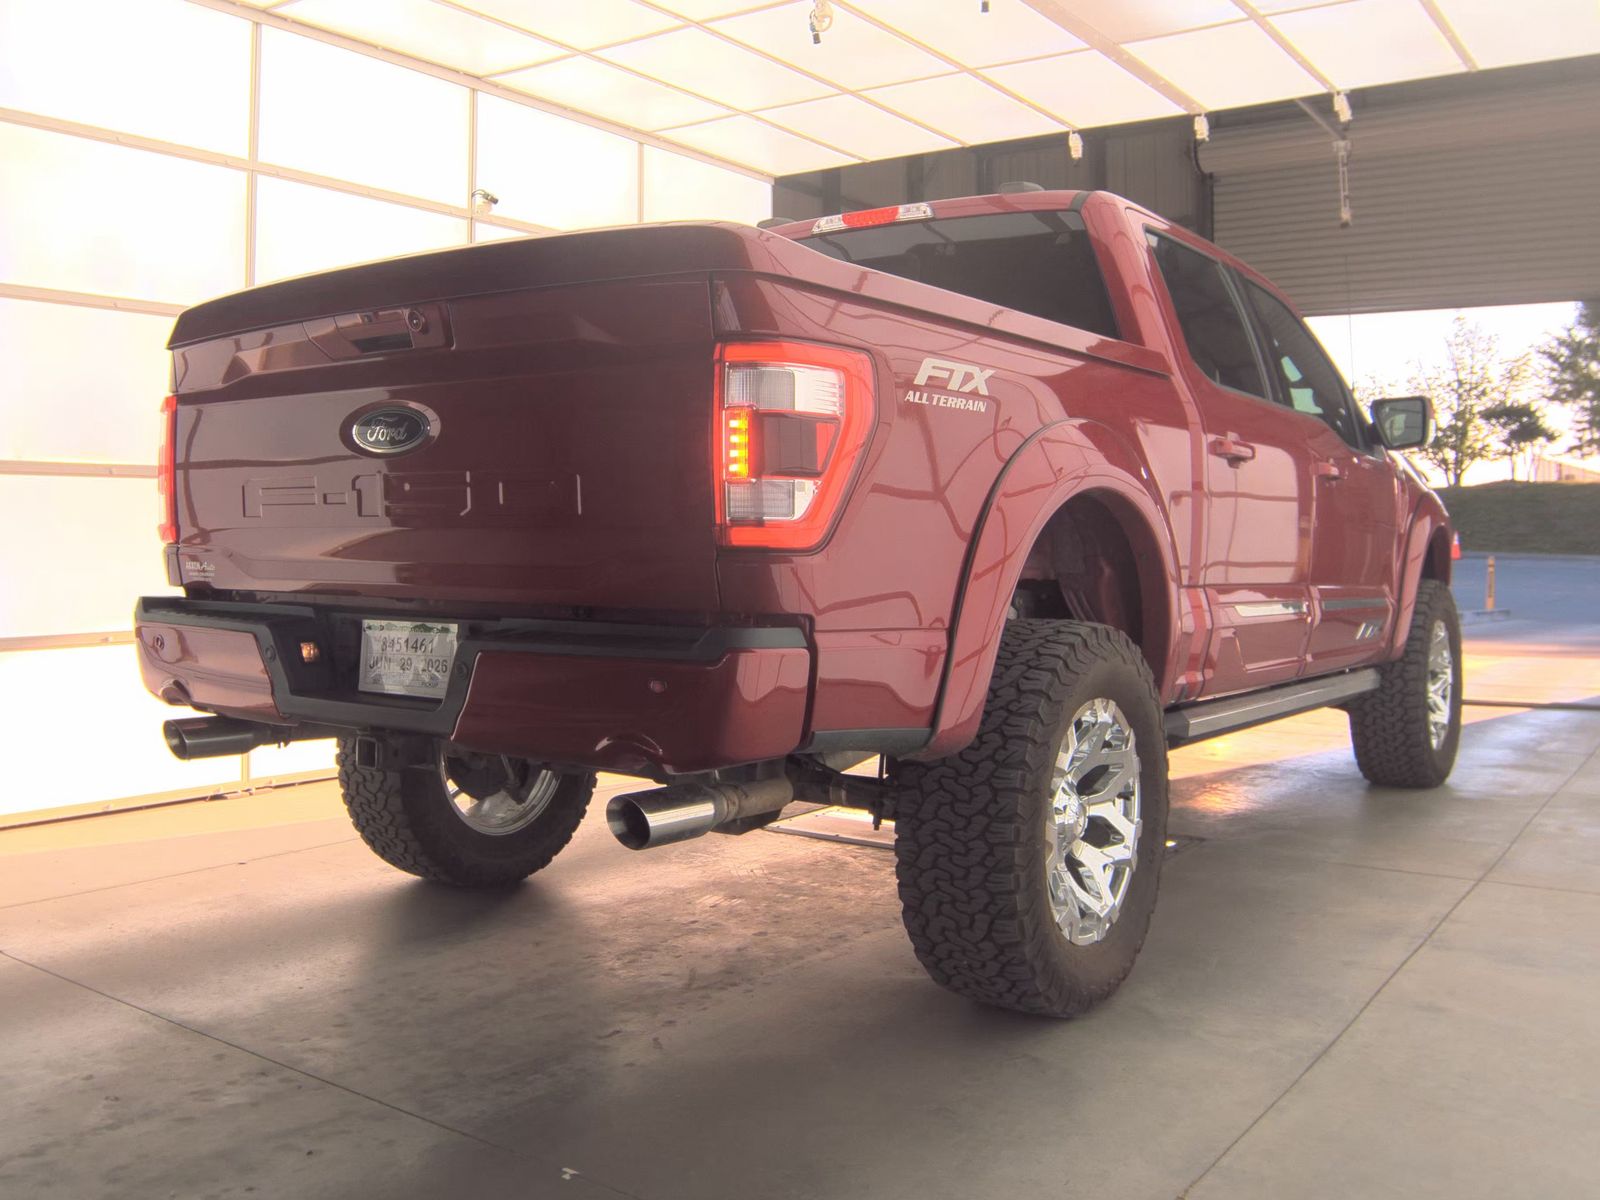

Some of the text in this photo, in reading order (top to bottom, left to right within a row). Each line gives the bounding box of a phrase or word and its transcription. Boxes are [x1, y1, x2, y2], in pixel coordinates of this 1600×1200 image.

[913, 357, 996, 396] FTX
[904, 390, 987, 412] ALL TERRAIN
[367, 417, 408, 441] Ford
